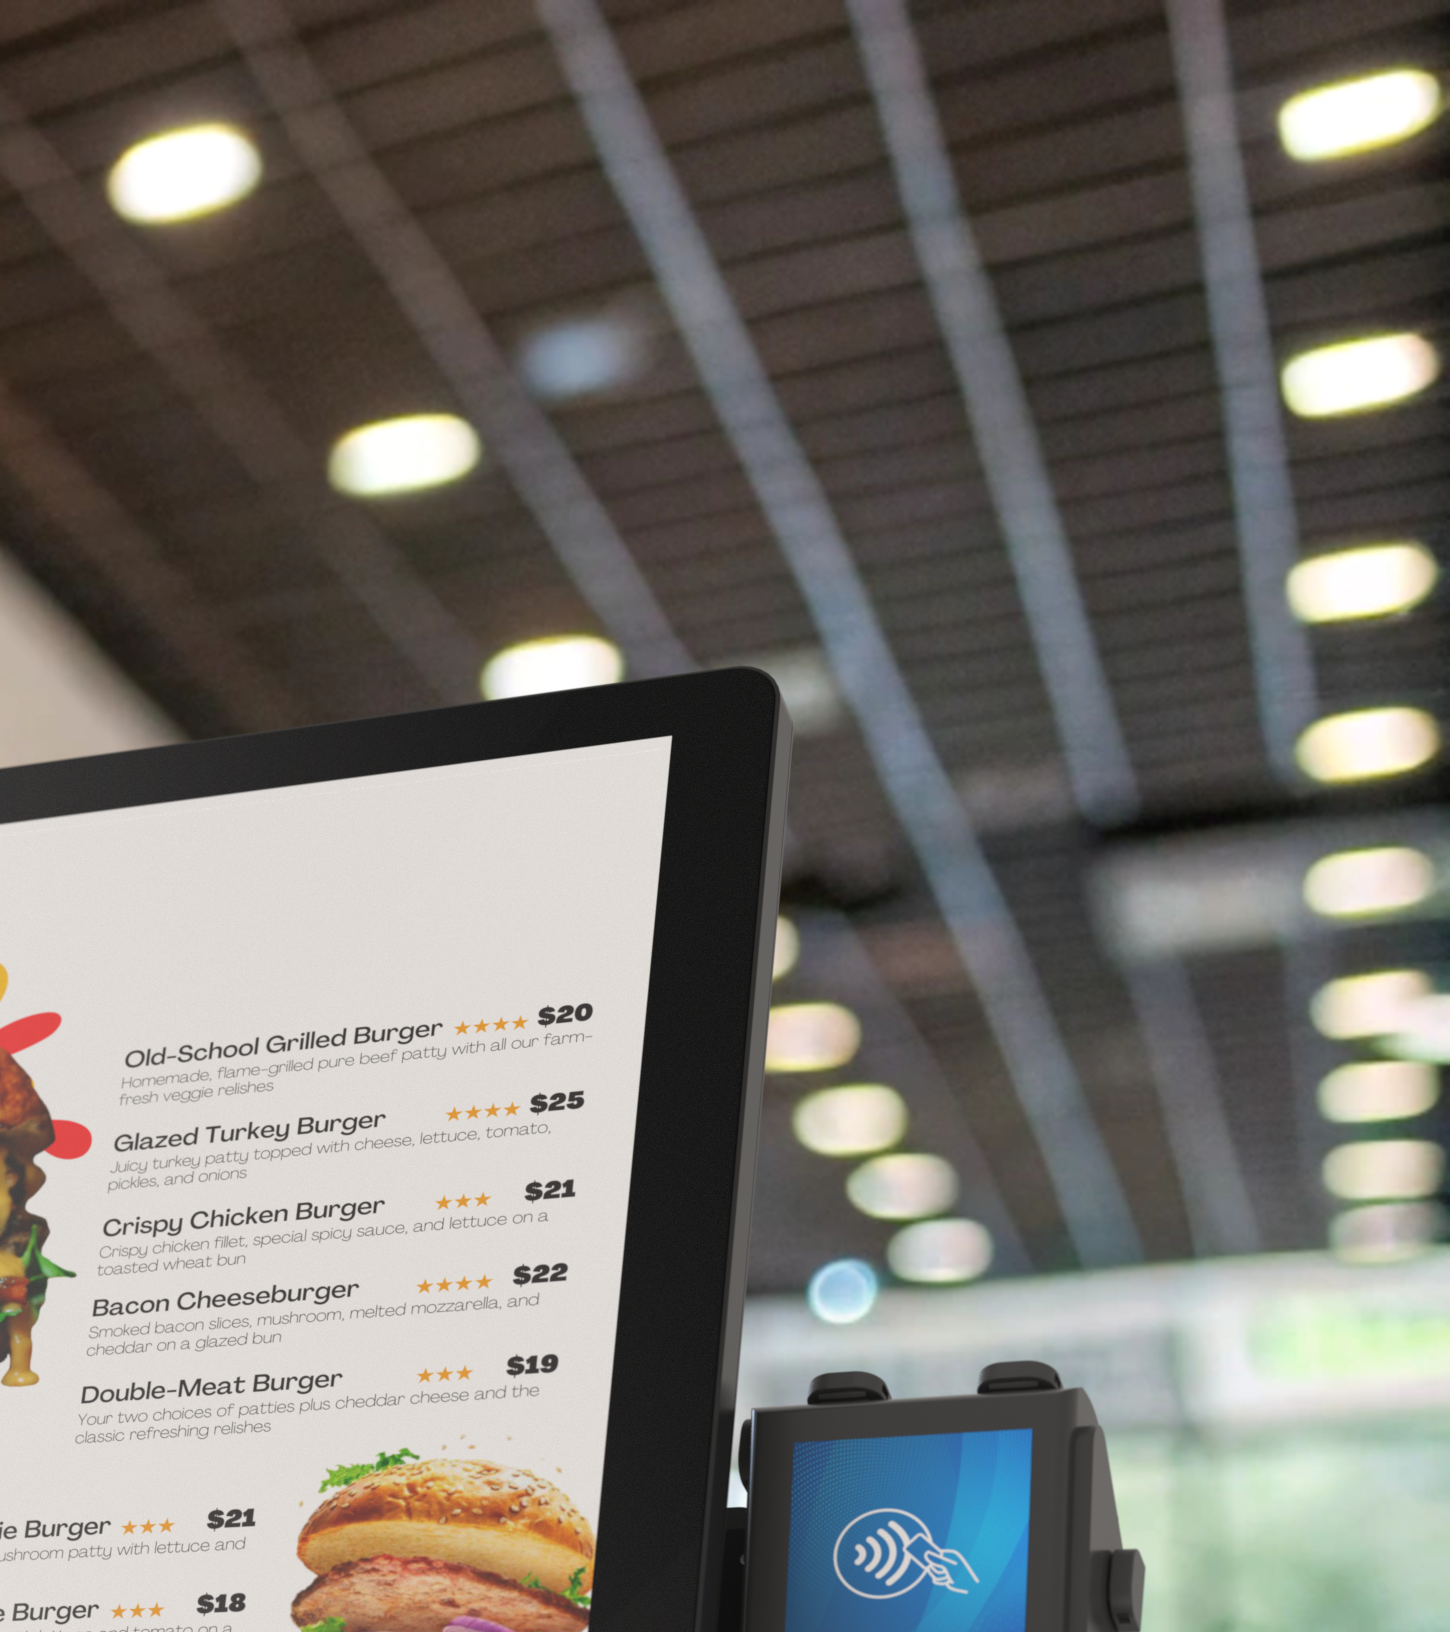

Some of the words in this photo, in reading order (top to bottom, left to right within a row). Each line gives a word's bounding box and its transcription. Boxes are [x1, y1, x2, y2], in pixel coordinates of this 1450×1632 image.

[124, 1036, 260, 1069] Old-School
[265, 1027, 348, 1054] Grilled
[353, 1022, 444, 1046] Burger
[537, 1002, 594, 1027] $20
[120, 1069, 213, 1089] Homemade,
[216, 1057, 315, 1080] flame-grilled
[317, 1055, 355, 1073] pure
[358, 1048, 399, 1066] beef
[400, 1046, 448, 1064] patty
[451, 1040, 486, 1056] with
[489, 1037, 508, 1053] all
[510, 1037, 540, 1050] our
[543, 1032, 593, 1047] farm-
[118, 1090, 159, 1106] fresh
[162, 1086, 214, 1104] veggie
[217, 1081, 275, 1097] relishes
[113, 1126, 200, 1153] Glazed
[205, 1121, 291, 1144] Turkey
[296, 1113, 387, 1137] Burger
[529, 1090, 585, 1115] $25
[109, 1160, 149, 1175] Juicy
[152, 1155, 202, 1170] turkey
[204, 1150, 250, 1168] patty
[253, 1142, 313, 1162] topped
[316, 1139, 351, 1155] with
[353, 1136, 416, 1152] cheese,
[419, 1129, 481, 1145] lettuce,
[485, 1122, 552, 1140] tomato,
[102, 1216, 184, 1238] Crispy
[189, 1206, 289, 1230] Chicken
[295, 1199, 386, 1223] Burger
[524, 1178, 576, 1203] $21
[98, 1245, 149, 1260] Crispy
[151, 1238, 211, 1255] chicken
[214, 1235, 249, 1249] fillet,
[252, 1228, 308, 1249] special
[310, 1227, 353, 1244] spicy
[356, 1223, 409, 1238] sauce,
[412, 1216, 446, 1234] and
[448, 1214, 508, 1230] lettuce
[511, 1212, 534, 1225] on
[537, 1211, 549, 1223] a
[92, 1297, 170, 1318] Bacon
[176, 1283, 360, 1311] Cheeseburger
[512, 1262, 569, 1287] $22
[88, 1321, 151, 1340] Smoked
[153, 1320, 205, 1335] bacon
[208, 1316, 253, 1331] slices,
[256, 1310, 345, 1327] mushroom,
[349, 1302, 407, 1320] melted
[410, 1296, 503, 1315] mozzarella,
[506, 1292, 541, 1309] and
[80, 1376, 246, 1405] Double-Meat
[252, 1372, 343, 1395] Burger
[506, 1353, 560, 1378] $19
[77, 1413, 114, 1426] Your
[117, 1411, 149, 1425] two
[152, 1407, 213, 1422] choices
[216, 1402, 236, 1418] of
[237, 1401, 296, 1419] patties
[298, 1398, 332, 1415] plus
[334, 1393, 406, 1410] cheddar
[409, 1390, 470, 1405] cheese
[473, 1385, 508, 1402] and
[511, 1383, 541, 1399] the
[74, 1429, 125, 1445] classic
[128, 1424, 210, 1441] refreshing
[213, 1420, 272, 1436] relishes
[24, 1519, 112, 1542] Burger
[206, 1507, 256, 1531] $21
[67, 1544, 113, 1562] patty
[116, 1541, 151, 1556] with
[153, 1540, 211, 1555] lettuce
[213, 1536, 247, 1552] and
[11, 1602, 100, 1626] Burger
[196, 1592, 247, 1616] $18
